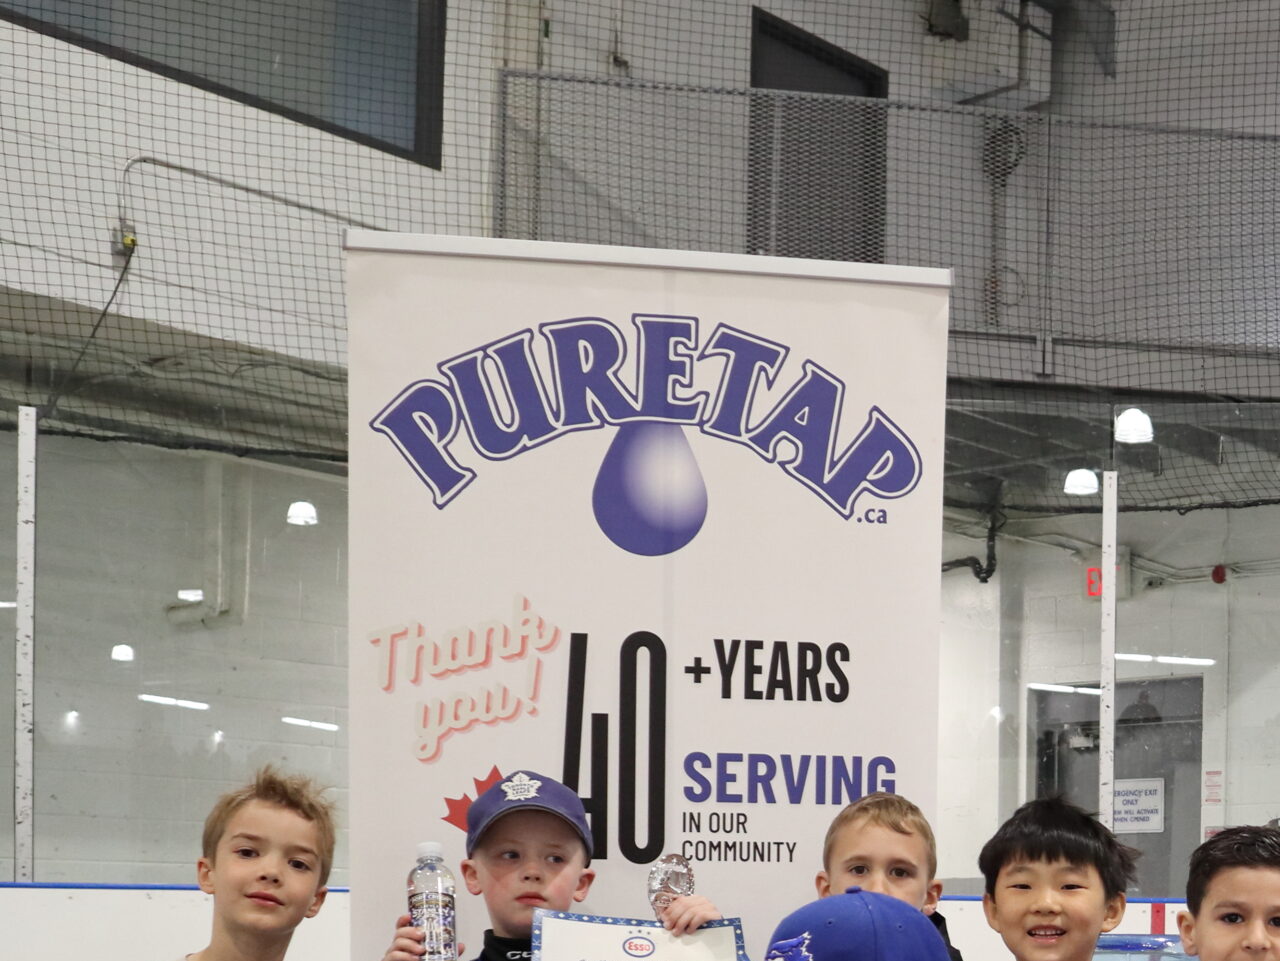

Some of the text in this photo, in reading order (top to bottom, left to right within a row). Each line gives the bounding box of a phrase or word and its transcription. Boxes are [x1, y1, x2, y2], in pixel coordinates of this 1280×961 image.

[369, 313, 922, 520] PURETAP
[856, 508, 888, 524] .ca
[367, 592, 562, 692] Thank
[413, 655, 543, 764] you!
[562, 630, 667, 865] 40
[683, 751, 896, 805] SERVING
[681, 840, 797, 863] COMMUNITY
[682, 811, 748, 834] IN OUR
